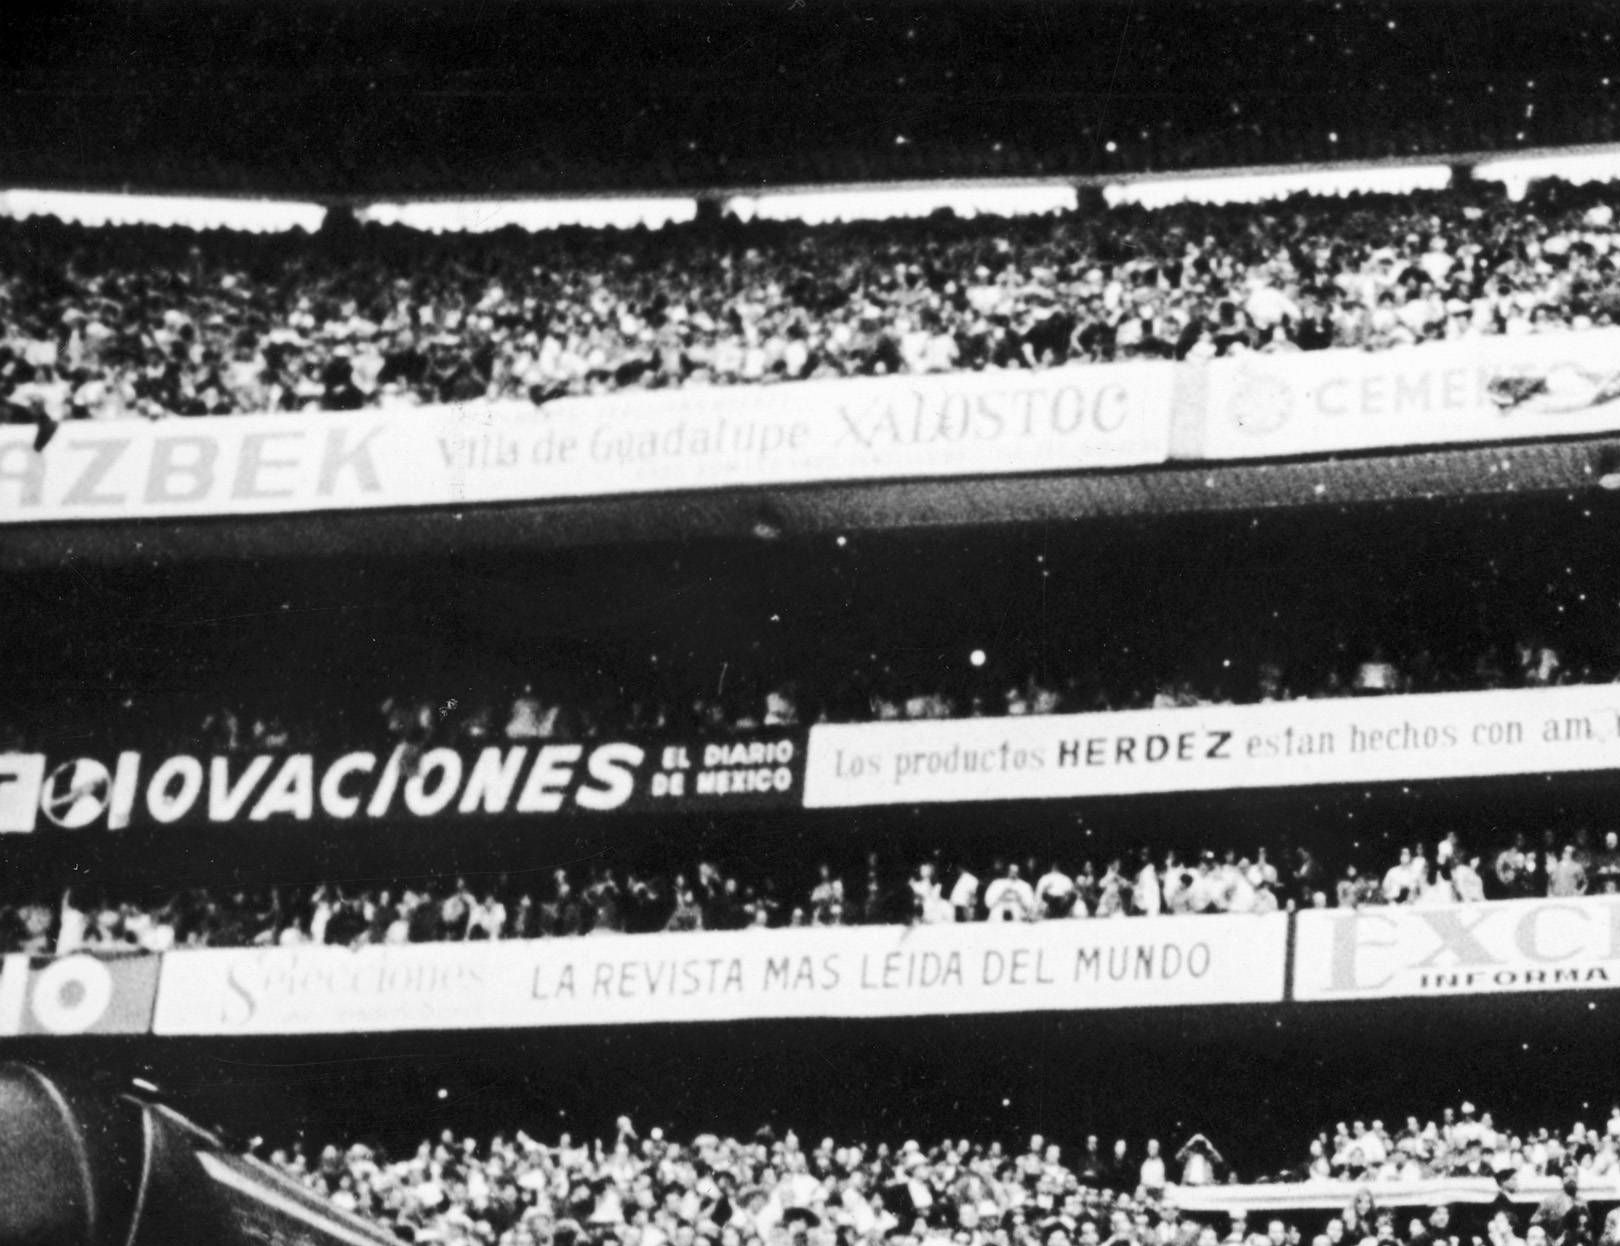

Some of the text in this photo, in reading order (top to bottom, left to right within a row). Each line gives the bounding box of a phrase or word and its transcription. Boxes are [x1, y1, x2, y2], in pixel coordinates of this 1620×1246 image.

[1314, 360, 1594, 416] CEME
[438, 382, 1129, 469] Villa de Guadalupe XALOSTOC
[662, 739, 794, 770] EL DIARIO
[834, 748, 882, 779] Los
[894, 738, 1046, 785] productos
[1057, 731, 1234, 769] HERDEZ
[1246, 727, 1337, 760] estan
[1350, 720, 1459, 754] hechos
[1472, 716, 1525, 746] con
[146, 742, 645, 824] OVACIONES
[651, 767, 793, 797] DE MEXICO
[530, 963, 575, 1000] LA
[593, 957, 743, 998] REVISTA
[763, 952, 841, 992] MAS
[982, 947, 1054, 986] DEL
[1074, 941, 1211, 983] MUNDO
[1419, 967, 1610, 988] INFORMA
